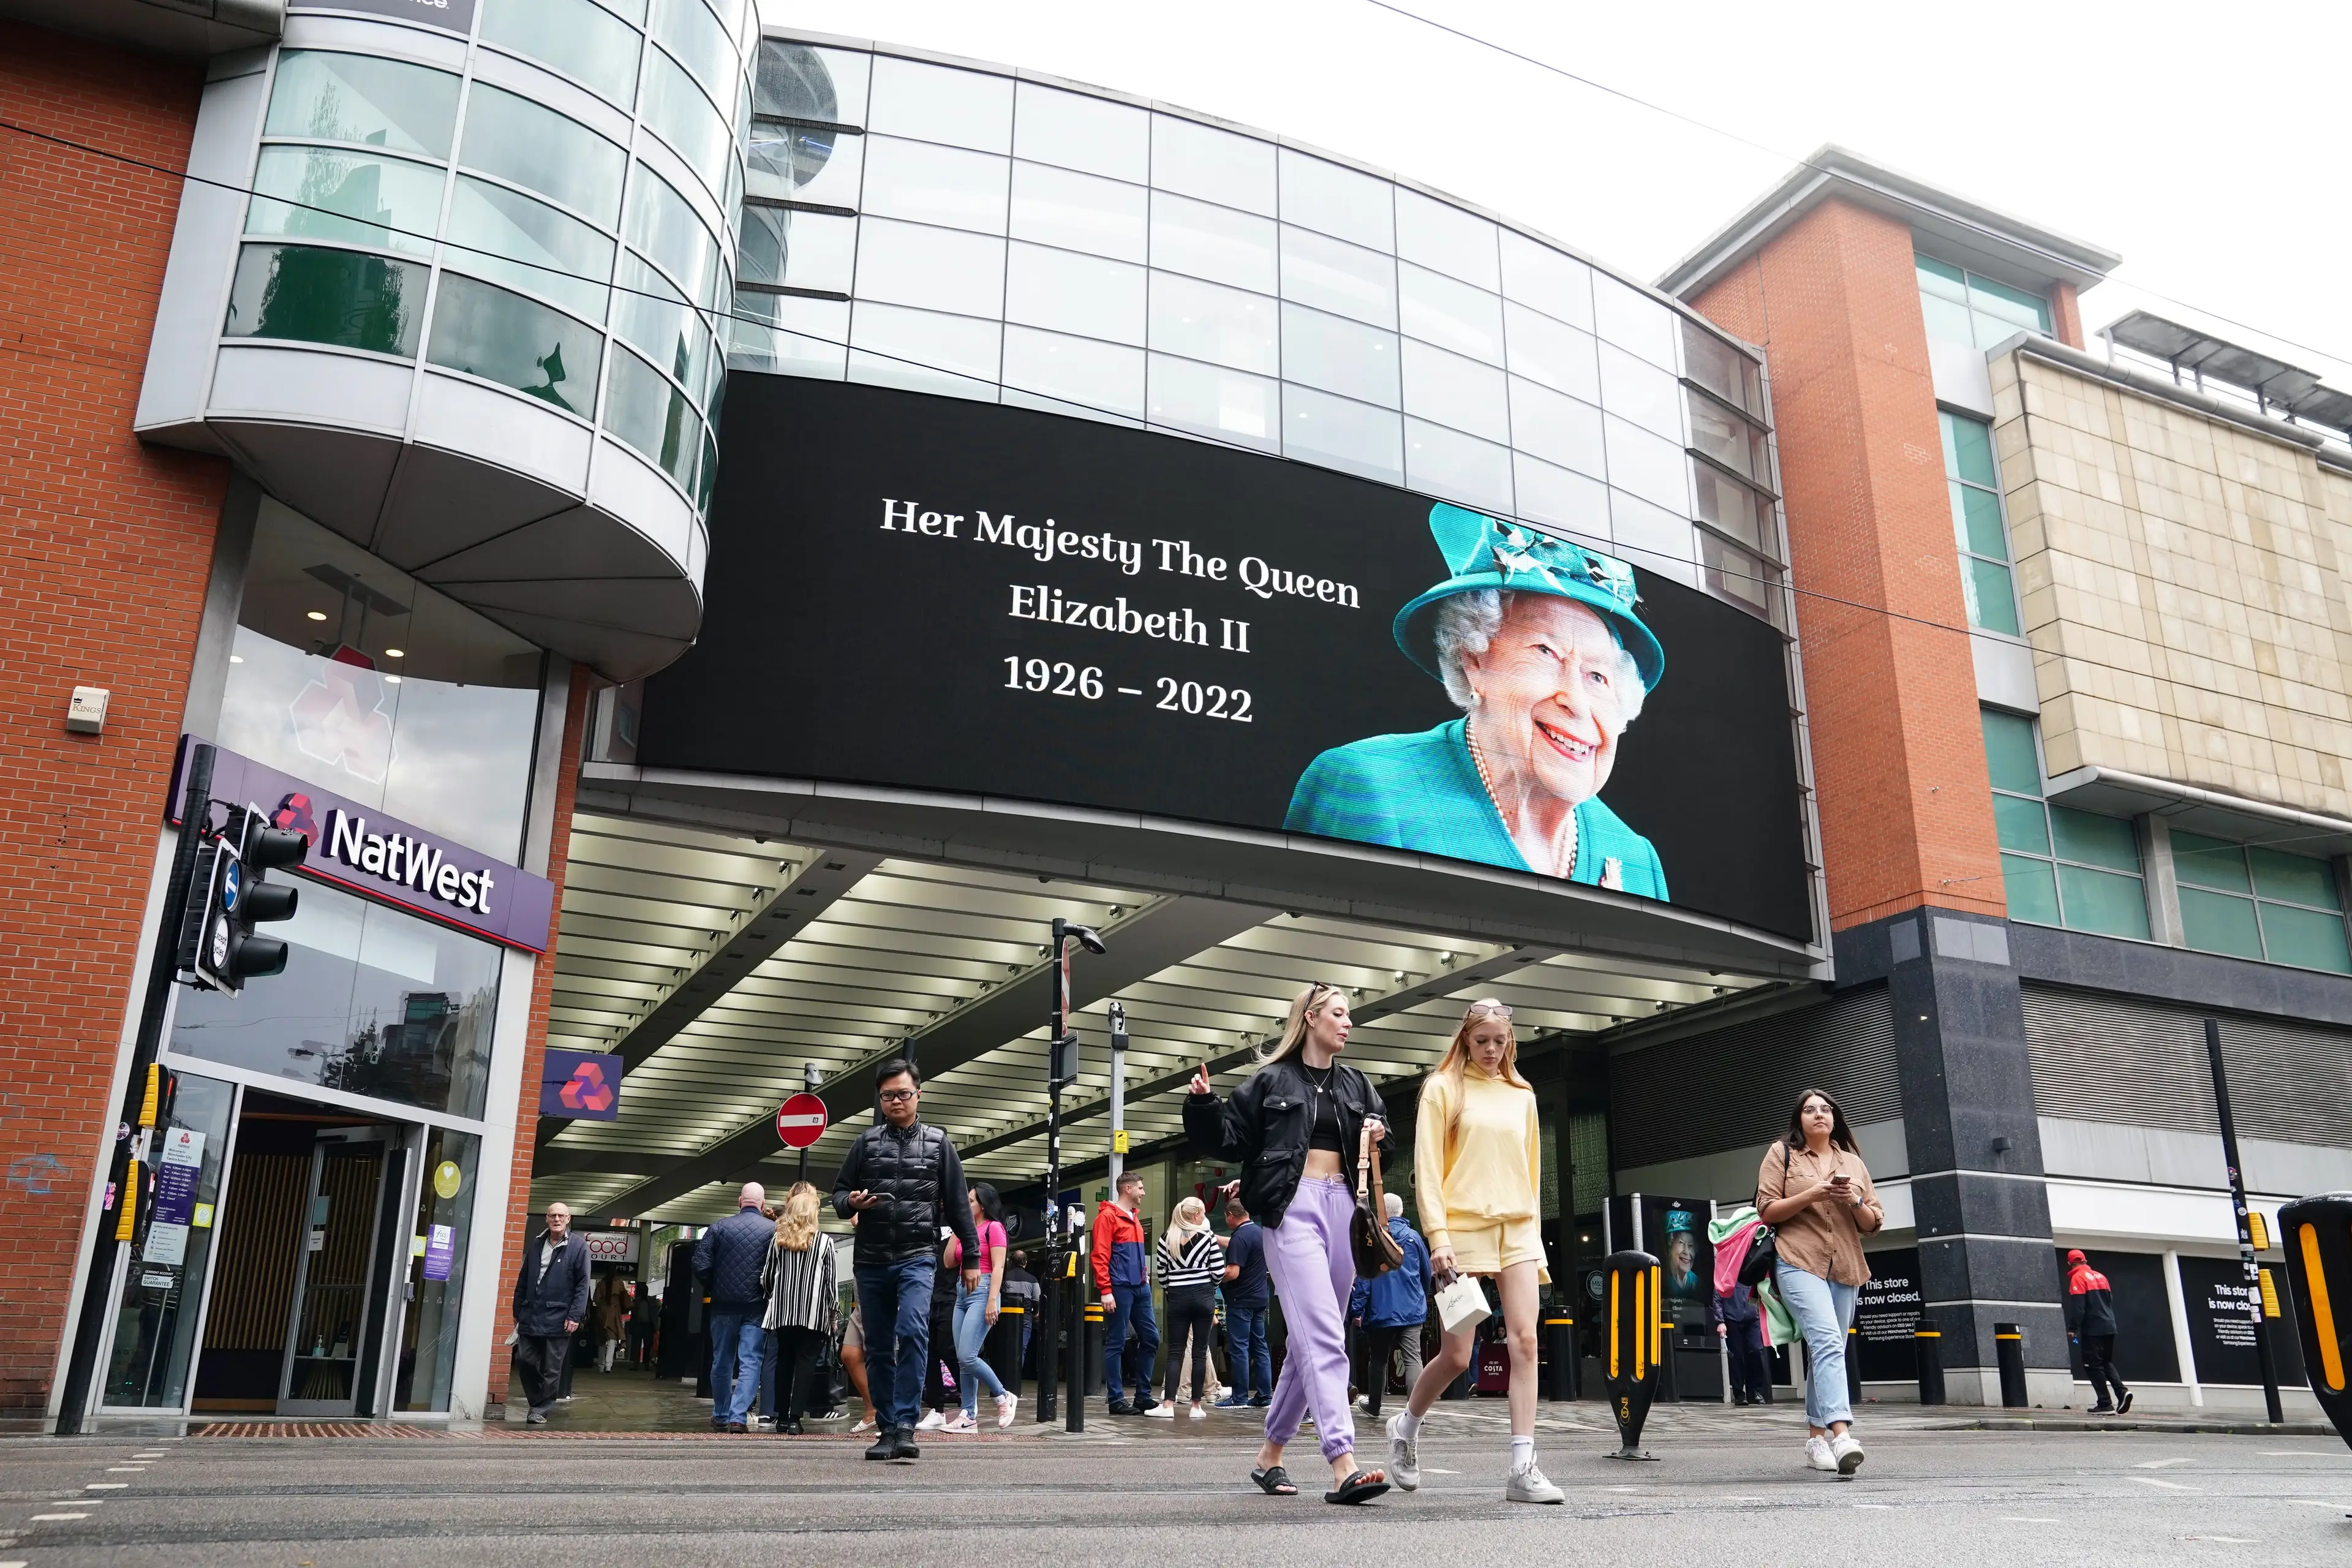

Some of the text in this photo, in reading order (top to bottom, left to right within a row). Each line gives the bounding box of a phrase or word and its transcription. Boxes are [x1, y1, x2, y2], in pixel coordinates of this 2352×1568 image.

[880, 499, 1360, 608] Her Majesty The Queen
[1009, 585, 1250, 652] Elizabeth II
[1005, 656, 1103, 699] 1926
[1156, 677, 1252, 722] 2022
[330, 809, 494, 914] NatWest
[1865, 1295, 1885, 1305] now
[1887, 1291, 1921, 1303] closed.
[1884, 1278, 1909, 1288] store
[2214, 1284, 2248, 1297] This stor
[2208, 1297, 2216, 1309] is
[2217, 1300, 2235, 1310] now
